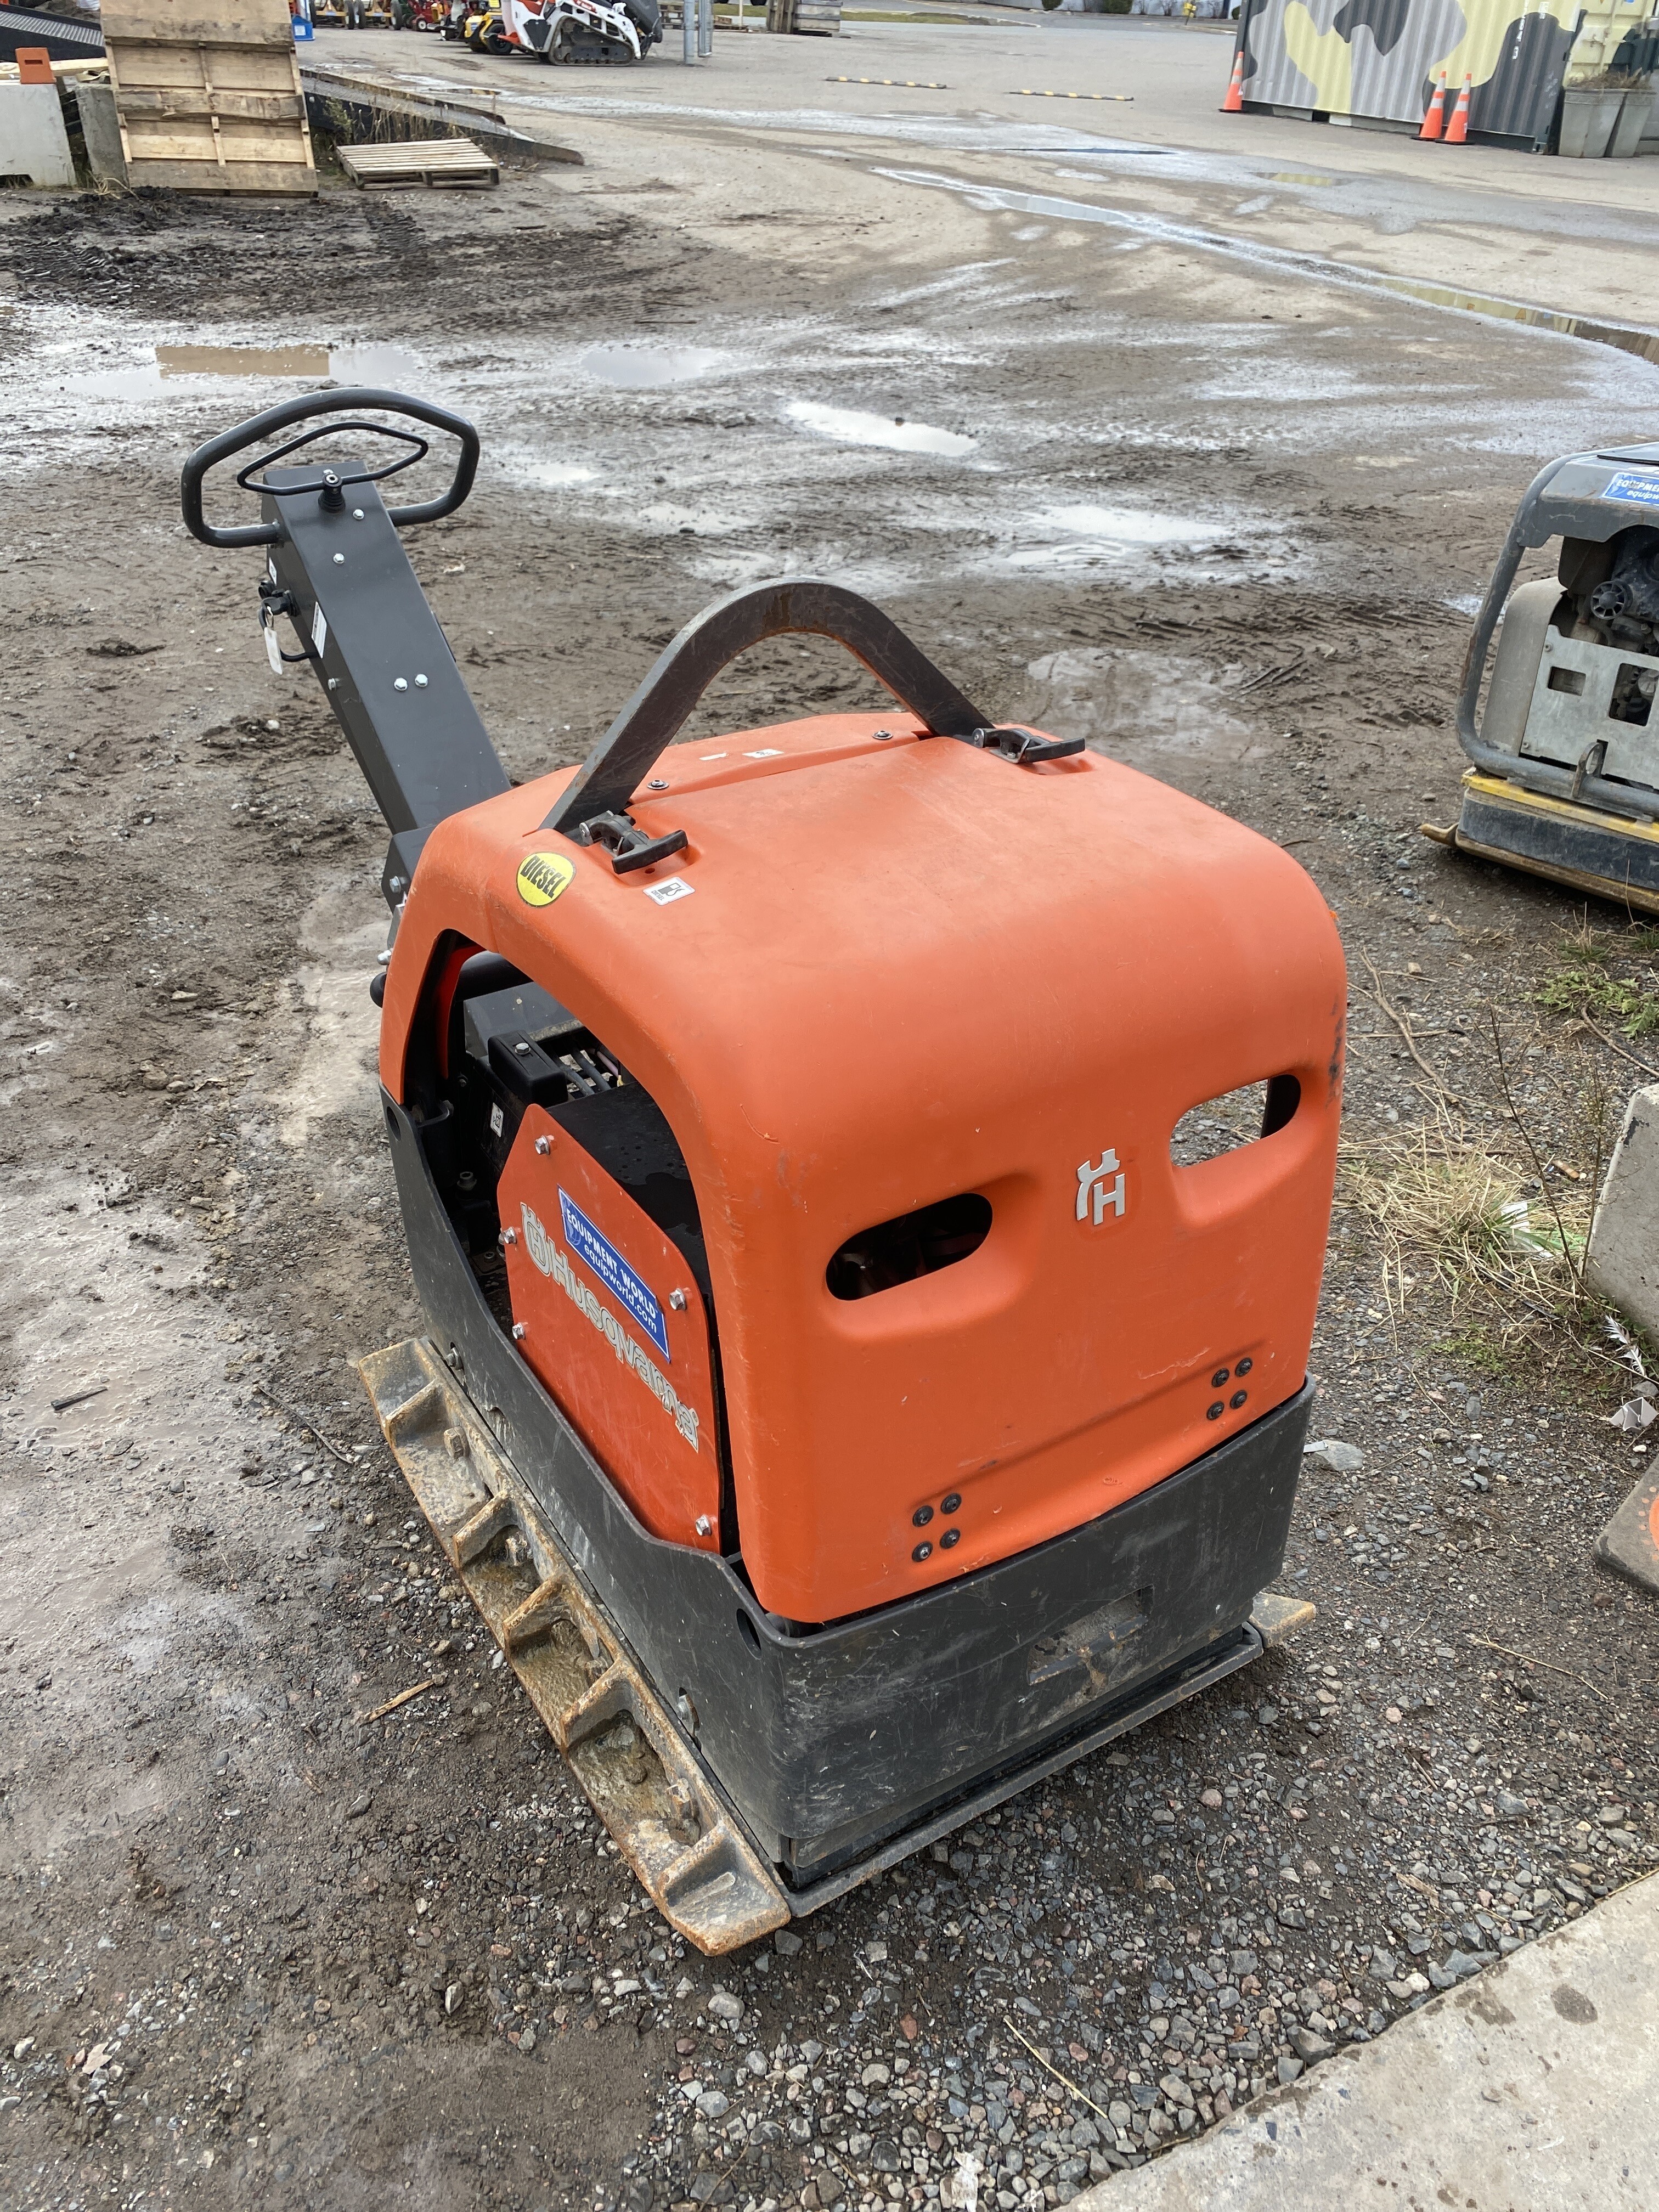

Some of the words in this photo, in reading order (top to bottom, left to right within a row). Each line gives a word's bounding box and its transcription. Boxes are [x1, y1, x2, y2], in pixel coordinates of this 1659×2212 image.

[1616, 479, 1659, 492] EQPME
[520, 855, 566, 899] DIESEL
[651, 890, 664, 901] DIESEL
[566, 1208, 617, 1274] EQUIPMENT
[620, 1268, 656, 1319] WORLD
[584, 1244, 657, 1334] equipworld.com
[548, 1237, 698, 1453] Husqvarna
